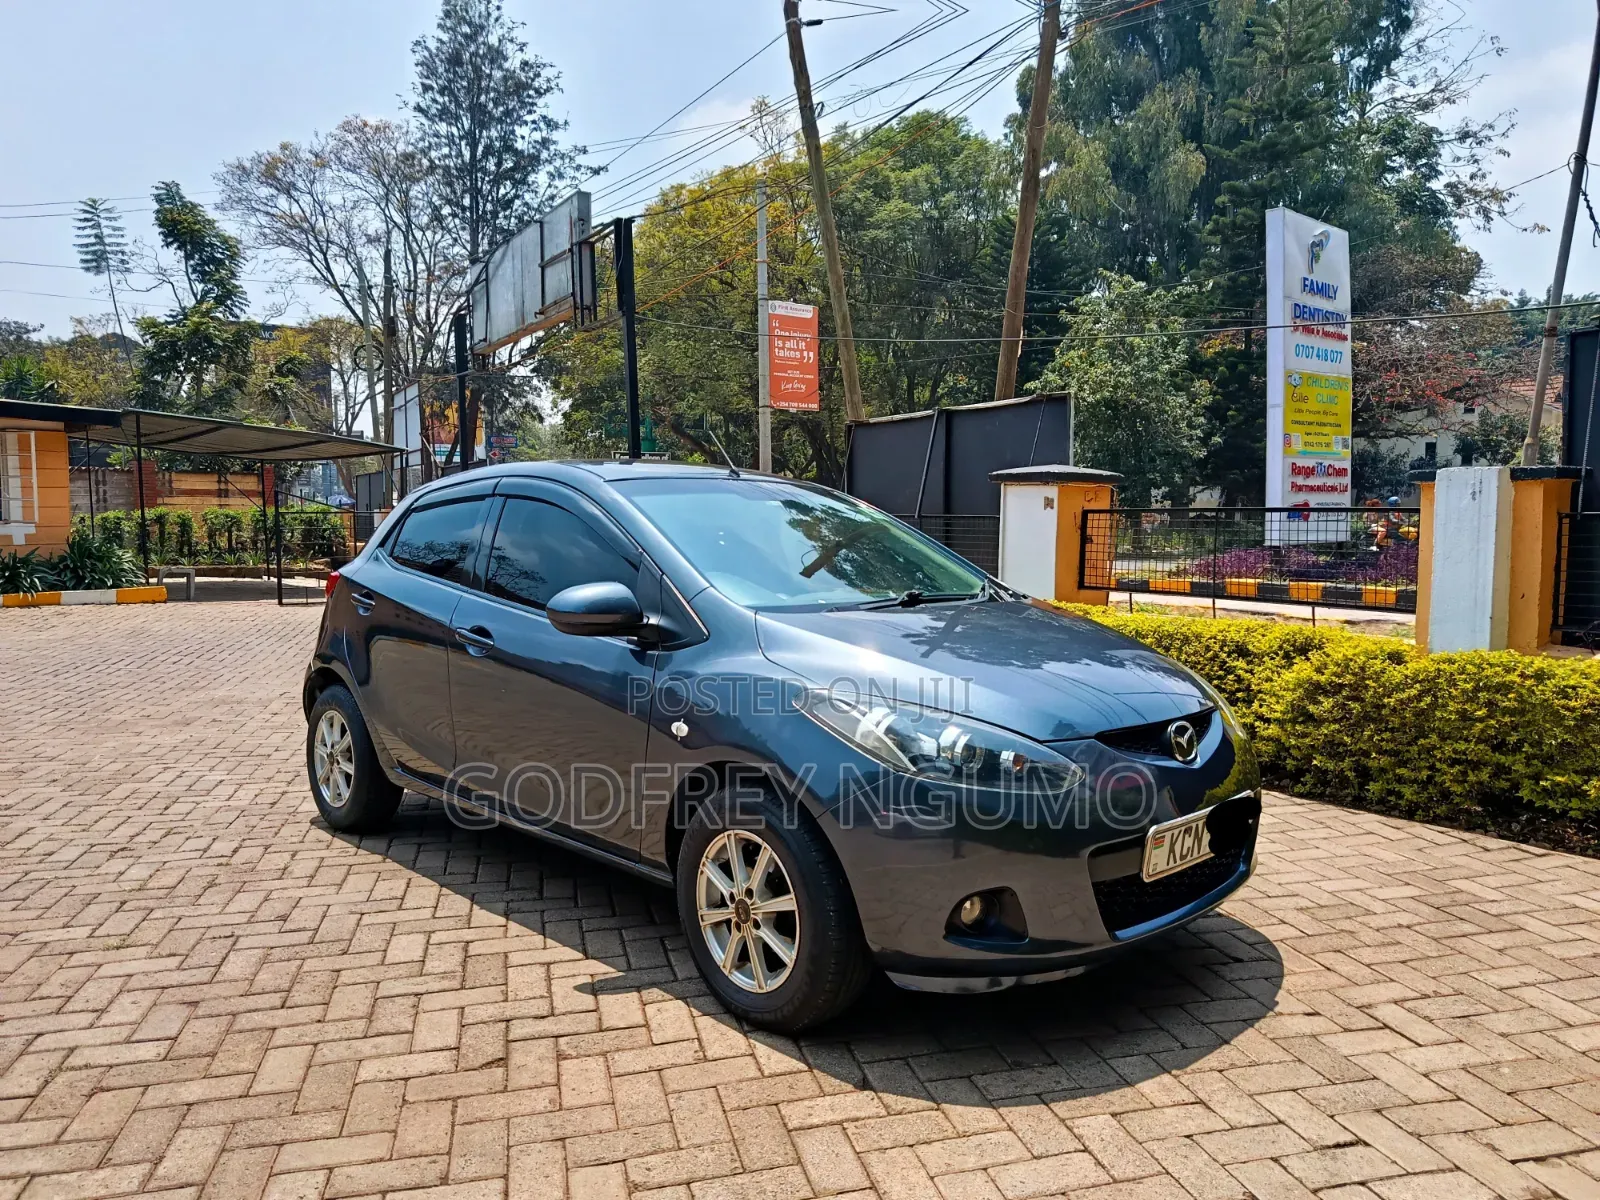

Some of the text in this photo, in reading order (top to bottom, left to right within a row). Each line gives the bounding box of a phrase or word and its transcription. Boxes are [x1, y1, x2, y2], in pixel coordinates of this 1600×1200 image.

[1301, 277, 1339, 300] FAMILY
[1293, 303, 1348, 328] DENTISTRY
[775, 329, 790, 337] One
[775, 337, 806, 350] is all it
[775, 347, 801, 358] takes
[1295, 343, 1343, 364] 0707 418 077
[1306, 376, 1349, 391] CHILDREN'S
[1316, 392, 1339, 405] CLINIC
[1291, 462, 1349, 478] Range Chem
[1166, 821, 1206, 867] KCN
